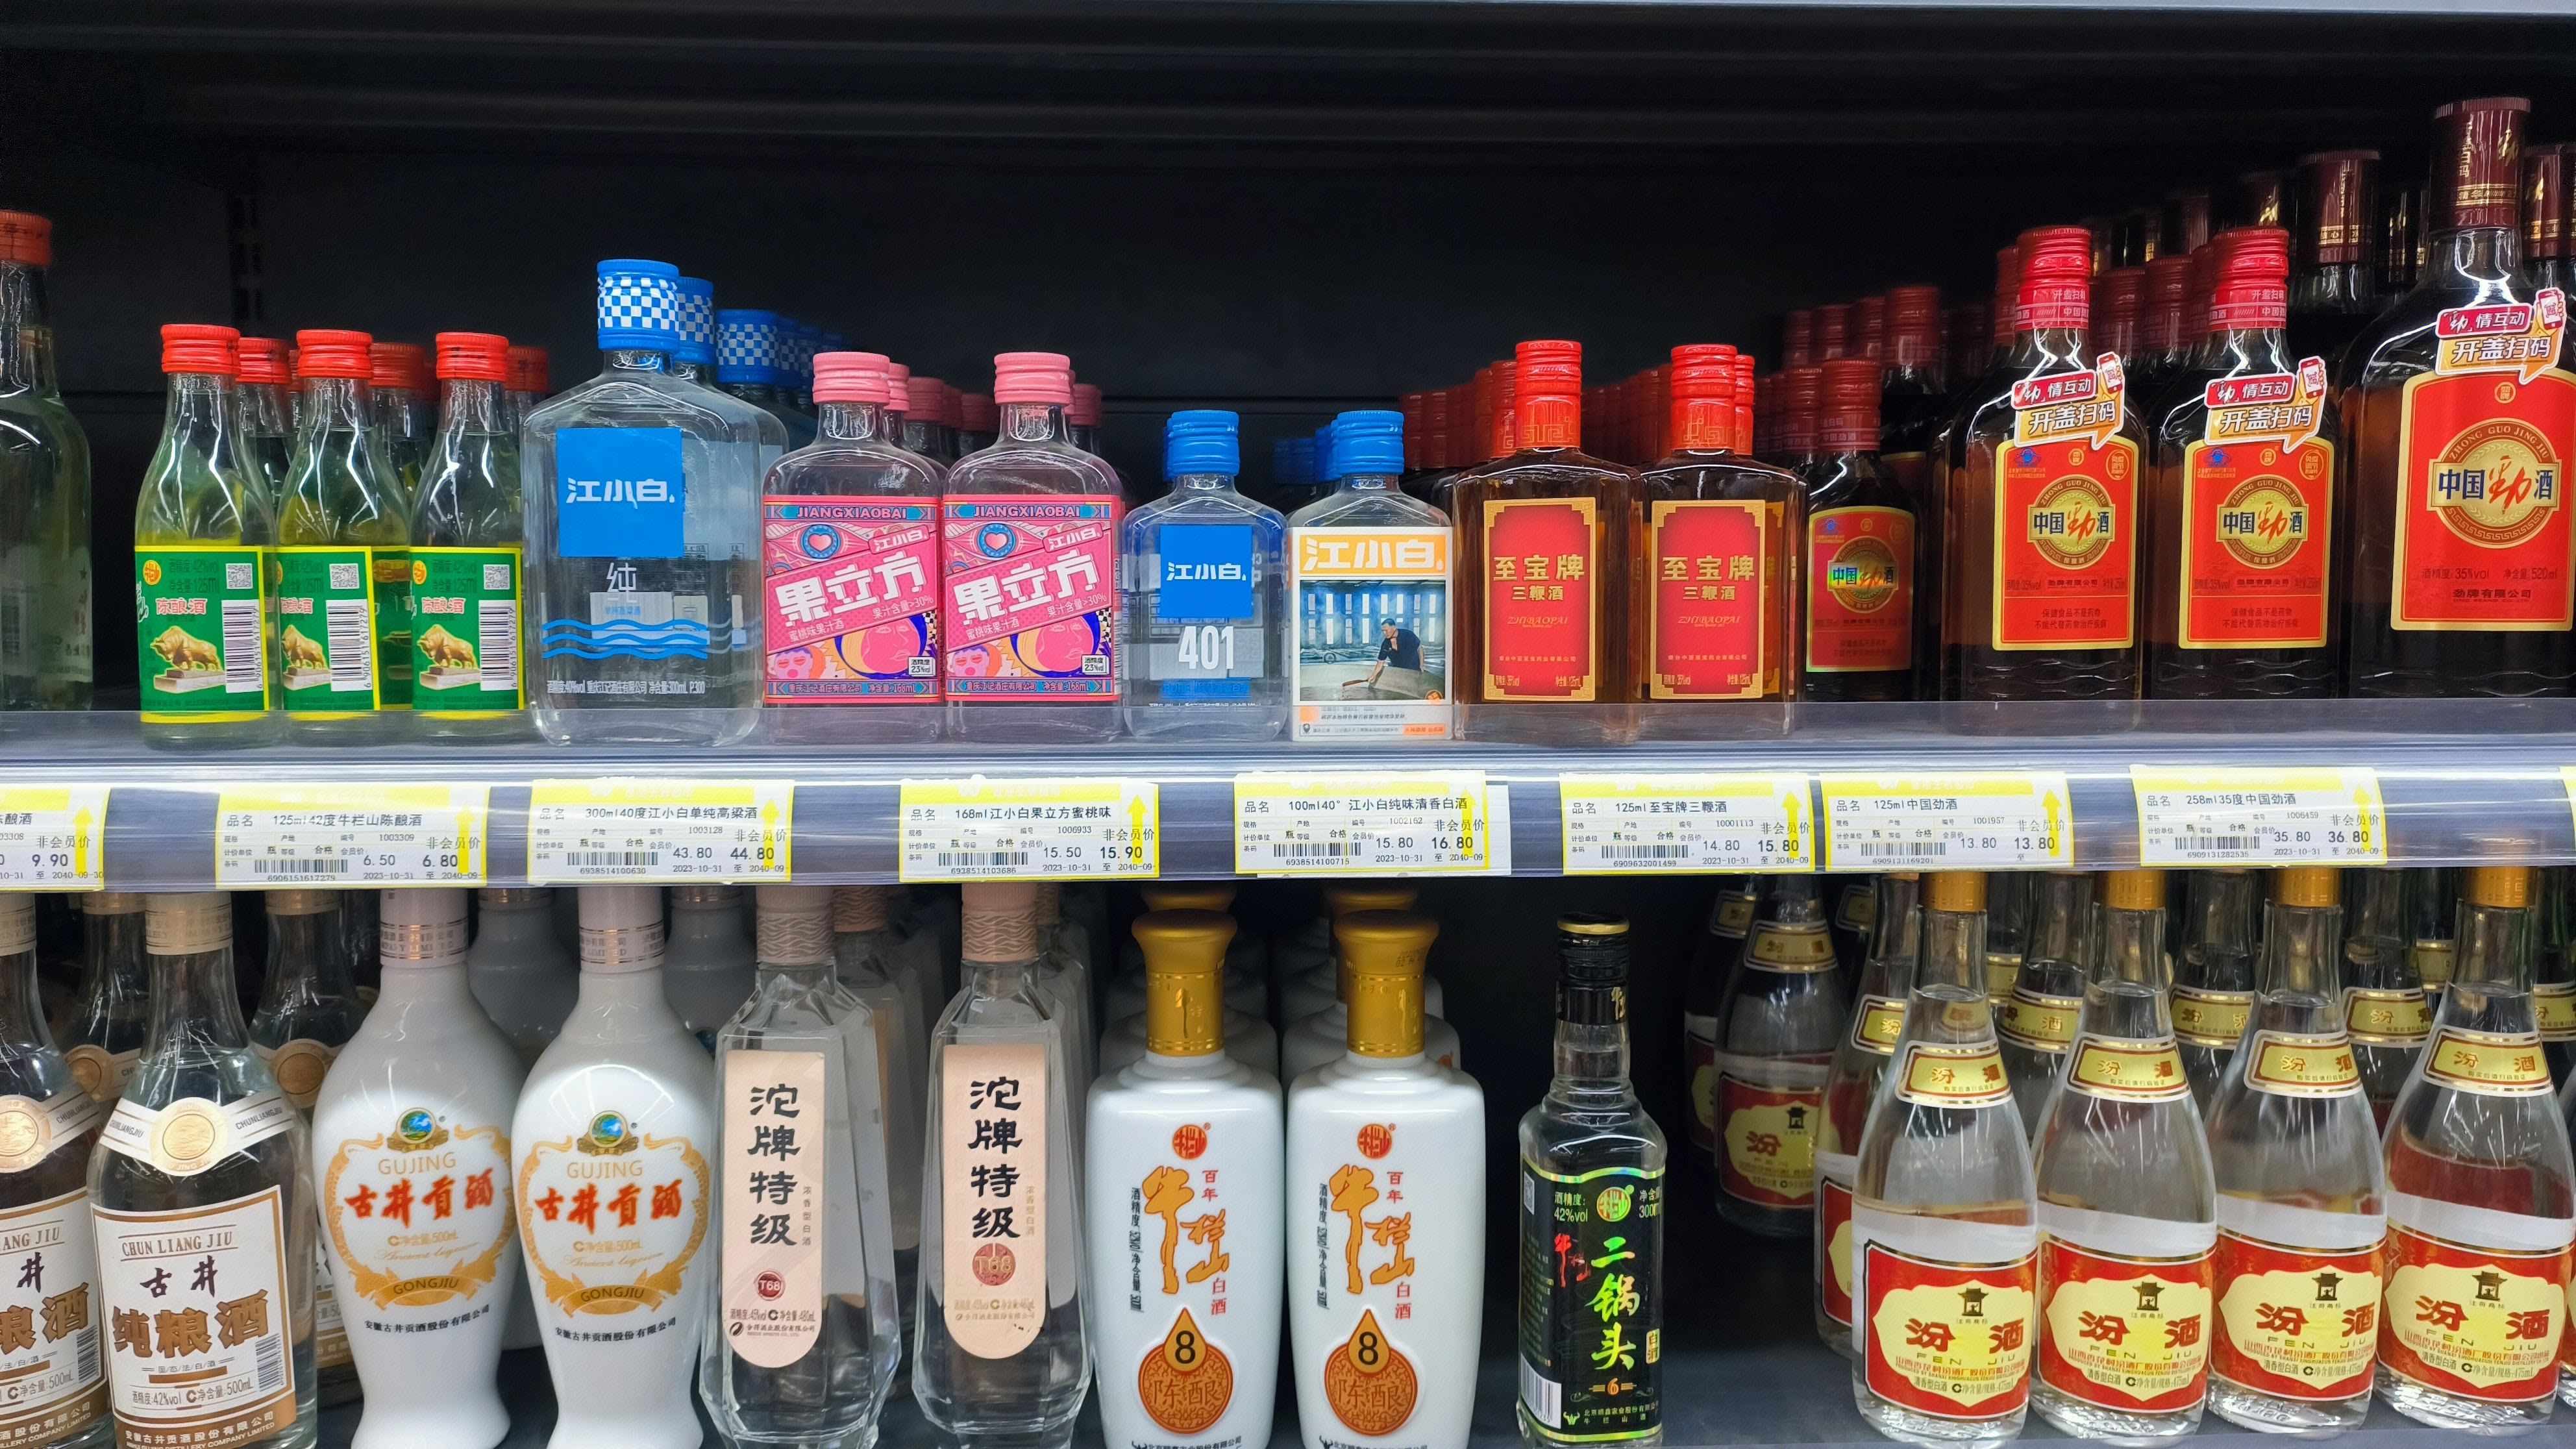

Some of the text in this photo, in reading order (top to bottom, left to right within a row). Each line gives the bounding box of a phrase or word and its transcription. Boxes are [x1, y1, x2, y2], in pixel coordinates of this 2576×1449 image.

[2451, 336, 2551, 364] 开盖扫码
[2029, 401, 2116, 434] 开盖扫码
[2220, 406, 2312, 433] 开盖扫码
[2449, 425, 2549, 460] ZHONG GUO JING JIU
[2438, 456, 2552, 509] 中国劲酒
[566, 478, 675, 509] 江小白
[797, 507, 906, 519] JIANGXIAOBAI
[974, 506, 1080, 517] JIANGXIAOBAI
[2033, 502, 2109, 541] 中国劲酒
[2223, 502, 2303, 543] 中国劲酒
[874, 529, 928, 552] 江小白
[1048, 527, 1101, 550] 江小白
[1303, 537, 1444, 571] 江小白
[1167, 562, 1246, 581] 江小白
[1493, 554, 1585, 581] 至宝牌
[1661, 555, 1755, 581] 至宝牌
[607, 562, 637, 603] 纯
[775, 551, 926, 627] 果立方
[953, 549, 1099, 625] 果立方
[1512, 585, 1563, 601] 三鞭酒
[1683, 585, 1735, 601] 三鞭酒
[155, 597, 207, 615] 陈酿酒
[422, 597, 466, 614] 陈酿酒
[788, 618, 845, 643] 蜜桃味果汁酒
[966, 616, 1021, 641] 蜜桃味果汁酒
[1178, 626, 1233, 670] 401
[1245, 801, 1269, 813] 品名
[1572, 802, 1597, 814] 品名
[1837, 801, 1860, 811] 品名
[2147, 795, 2170, 807] 品名
[227, 815, 253, 826] 品名
[539, 808, 565, 820] 品名
[911, 809, 935, 821] 品名
[2331, 813, 2379, 826] 非会员价
[1434, 819, 1485, 832] 非会员价
[1760, 821, 1810, 835] 非会员价
[1914, 829, 1932, 838] 合格
[2017, 820, 2066, 832] 非会员价
[2229, 823, 2246, 832] 合格
[36, 836, 91, 848] 非会员价
[734, 829, 787, 842] 非会员价
[1102, 828, 1154, 841] 非会员价
[1330, 829, 1346, 839] 合格
[1657, 832, 1674, 841] 合格
[2274, 831, 2310, 843] 35.80
[2329, 831, 2369, 843] 36.80
[315, 846, 333, 855] 合格
[426, 837, 481, 849] 非会员价
[626, 838, 643, 848] 合格
[997, 838, 1013, 848] 合格
[1376, 837, 1414, 848] 15.80
[1431, 837, 1473, 850] 16.80
[1703, 840, 1740, 851] 14.80
[1758, 839, 1799, 852] 15.80
[1961, 837, 1997, 848] 13.80
[2014, 837, 2055, 850] 13.80
[673, 847, 712, 859] 43.80
[730, 848, 774, 860] 44.80
[1043, 847, 1082, 858] 15.50
[1100, 847, 1143, 860] 15.90
[2274, 847, 2320, 856] 2023-10-31
[32, 854, 68, 867] 9.90
[364, 854, 395, 866] 6.50
[423, 854, 458, 867] 6.80
[1043, 863, 1091, 872] 2023-10-31
[1702, 856, 1749, 865] 2023-10-31
[378, 1152, 456, 1175] GUJING
[747, 1084, 801, 1246] 沱牌特级
[968, 1076, 1022, 1239] 沱牌特级
[567, 1160, 643, 1179] GUJING
[1202, 1170, 1219, 1201] 百年
[1386, 1171, 1404, 1204] 百年
[345, 1168, 494, 1228] 古井贡酒
[536, 1179, 683, 1234] 古井贡酒
[1554, 1207, 1588, 1222] 42%vol
[802, 1186, 811, 1245] 浓香型白酒
[122, 1232, 232, 1257] CHUN LIANG JIU
[975, 1256, 1013, 1272] T68
[140, 1256, 218, 1298] 古井
[393, 1278, 460, 1294] GONGJIU
[760, 1280, 780, 1291] T68
[580, 1287, 645, 1303] GONGJIU
[1211, 1278, 1226, 1315] 白酒
[1395, 1282, 1412, 1320] 白酒
[1585, 1236, 1640, 1370] 二锅头
[112, 1289, 268, 1359] 纯粮酒
[364, 1304, 489, 1333] 安徽古井贡酒股份有限公司
[2268, 1336, 2366, 1349] FEN JIU
[2427, 1329, 2473, 1346] FEN
[1175, 1330, 1196, 1364] 8
[1358, 1331, 1379, 1365] 8
[2090, 1345, 2192, 1360] FEN JIU
[1916, 1352, 2015, 1365] FEN JIU
[2422, 1352, 2457, 1370] 清香型白酒
[1914, 1376, 1947, 1391] 清香型白酒
[2088, 1368, 2121, 1385] 清香型白酒
[1153, 1379, 1221, 1409] 陈酿
[1337, 1379, 1405, 1409] 陈酿
[1607, 1378, 1619, 1394] 6
[29, 1413, 91, 1442] COMPANY LIMITED
[125, 1411, 273, 1444] 安徽古井贡酒股份有限公司
[208, 1422, 275, 1448] COMPANY LIMITED
